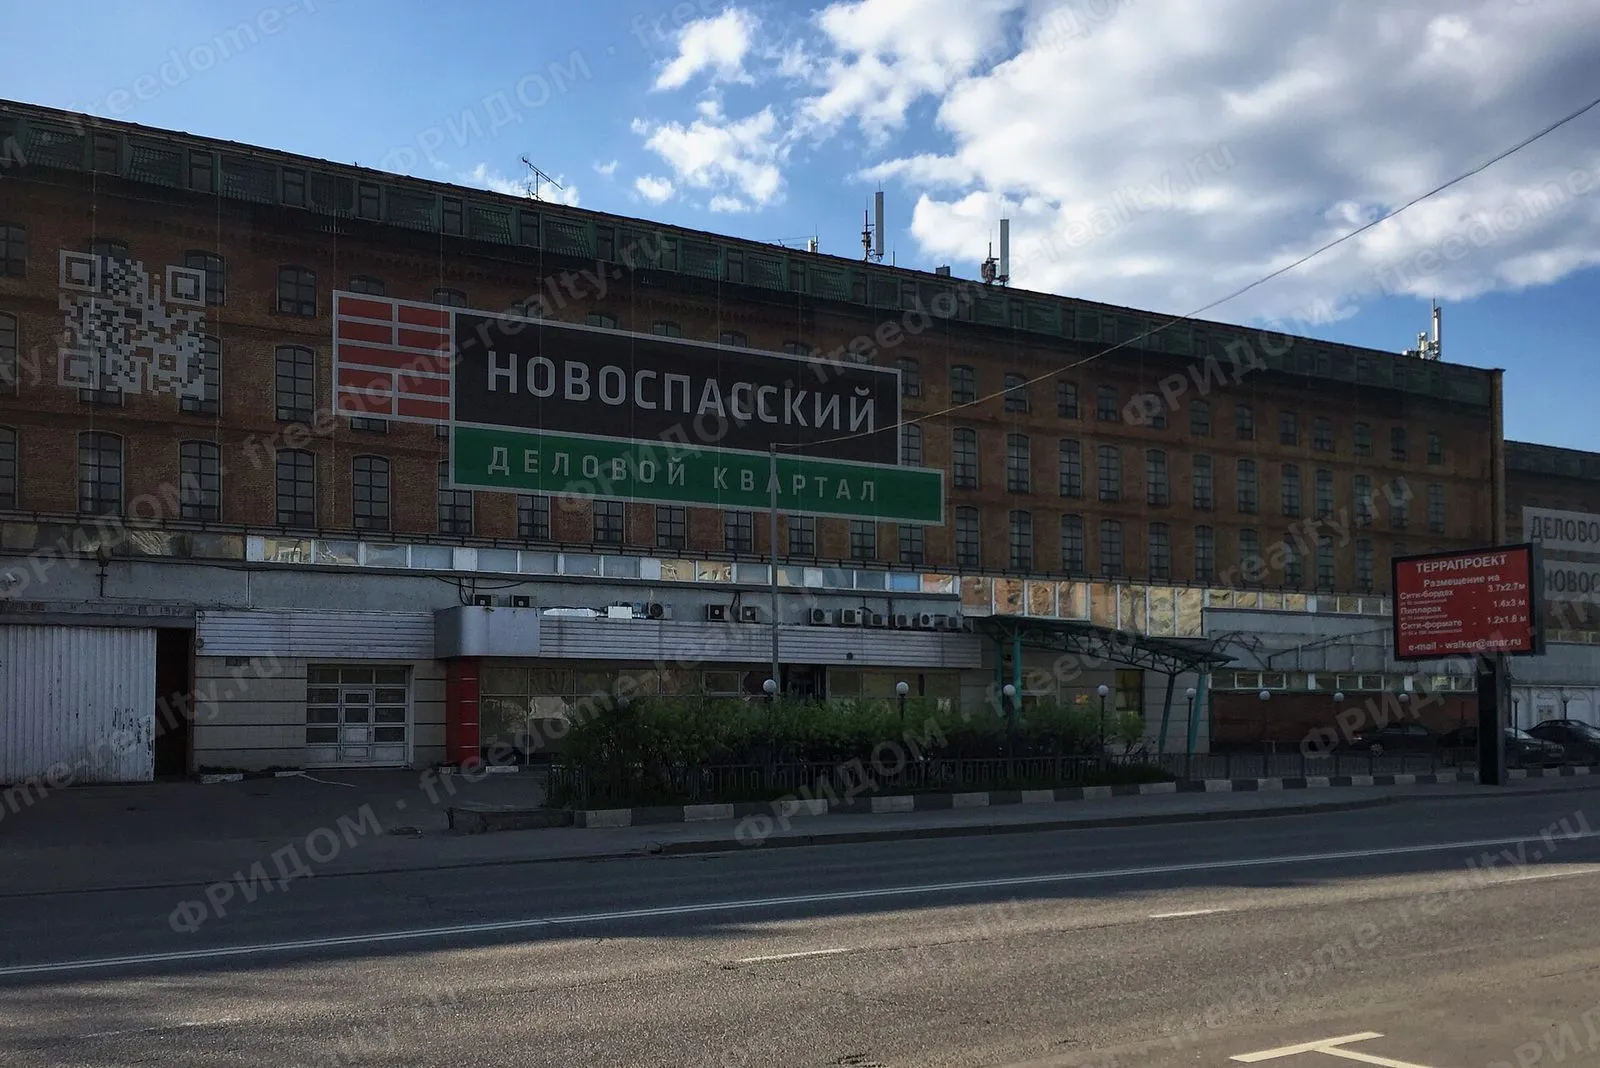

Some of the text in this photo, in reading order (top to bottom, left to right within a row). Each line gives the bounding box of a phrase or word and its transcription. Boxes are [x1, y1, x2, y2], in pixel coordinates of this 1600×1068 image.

[487, 351, 875, 434] НОВОСПАССКИЙ
[487, 445, 876, 502] ДЕЛОВОЙ КВАРТАЛ
[1530, 515, 1600, 542] ДЕЛОВО
[1416, 555, 1507, 573] ТЕРРАПРОЕКТ
